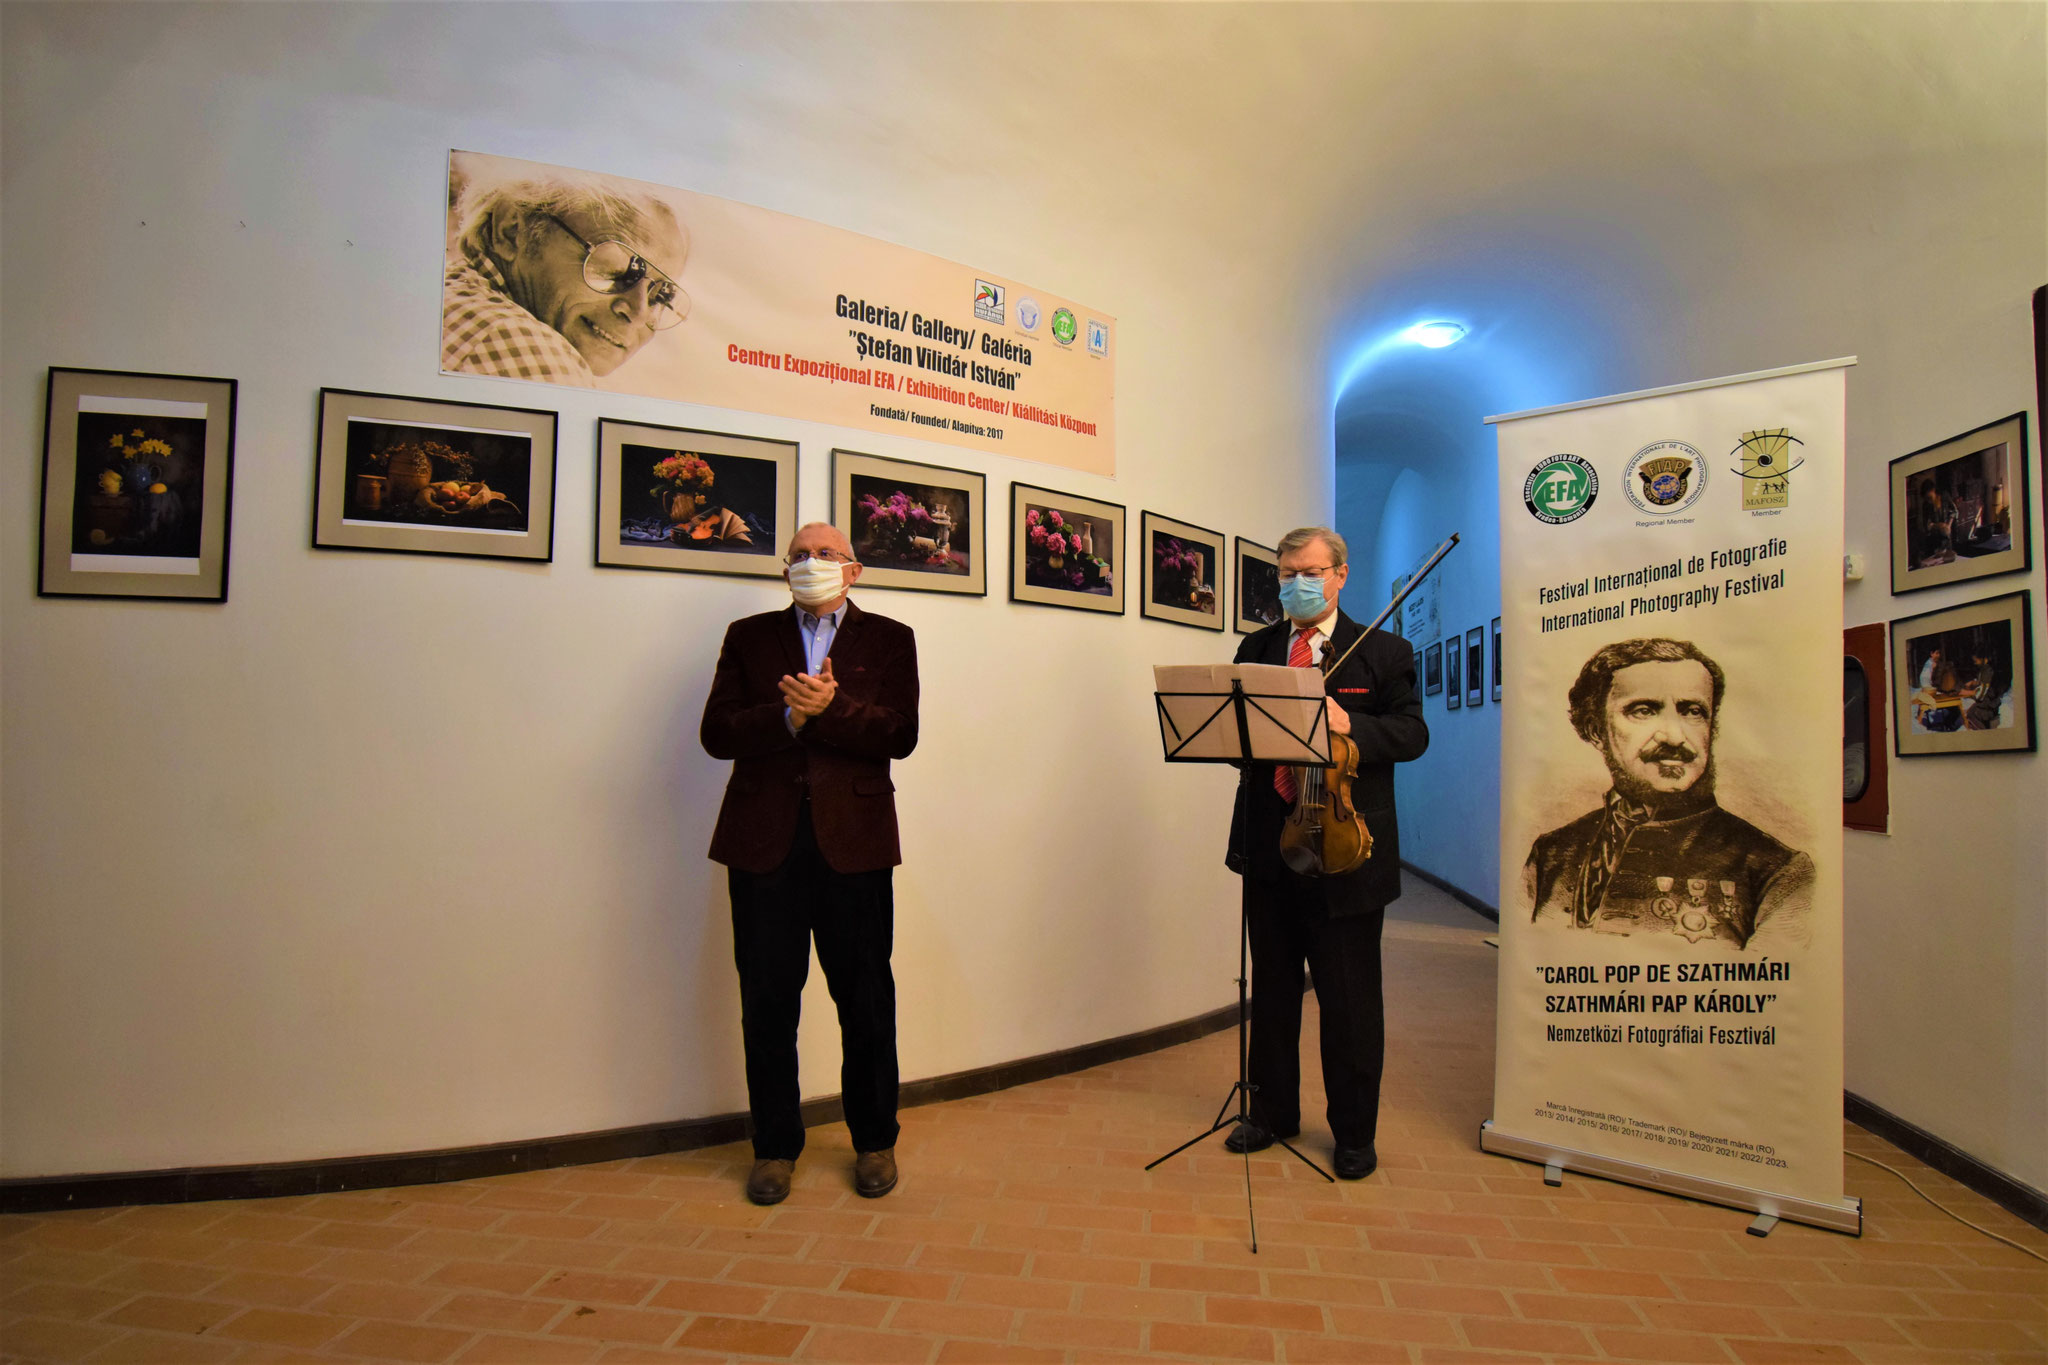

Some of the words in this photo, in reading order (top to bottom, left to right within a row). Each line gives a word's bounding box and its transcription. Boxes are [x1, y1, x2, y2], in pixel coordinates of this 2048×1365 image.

[835, 293, 908, 330] Galeria/
[911, 313, 976, 351] Gallery/
[981, 332, 1032, 366] Galéria
[916, 345, 968, 379] Vilidár
[727, 343, 780, 370] Centru
[784, 353, 871, 386] Expozițional
[874, 369, 895, 391] EFA
[897, 375, 905, 392] /
[906, 377, 966, 406] Exhibition
[968, 391, 1010, 416] Center/
[1012, 401, 1058, 428] Kiállítási
[1060, 413, 1097, 438] Központ
[870, 404, 909, 423] Fondată/
[911, 411, 950, 431] Founded/
[952, 420, 985, 438] Alapítva:
[987, 426, 1004, 440] 2017
[1627, 443, 1665, 477] INTERNATIONALE
[1647, 460, 1685, 475] FIAP
[1544, 480, 1582, 502] EFA
[1745, 496, 1784, 506] MAFOSZ
[1635, 520, 1665, 528] Regional
[1667, 517, 1695, 525] Member
[1751, 509, 1782, 517] Member
[1539, 579, 1589, 605] Festival
[1594, 559, 1682, 593] Internațional
[1688, 555, 1705, 574] de
[1711, 537, 1787, 571] Fotografie
[1541, 601, 1625, 633] International
[1630, 584, 1719, 616] Photography
[1725, 568, 1785, 599] Festival
[1605, 965, 1641, 983] POP
[1647, 964, 1671, 983] DE
[1677, 957, 1790, 982] SZATHMÁRI
[1545, 989, 1645, 1013] SZATHMÁRI
[1652, 994, 1687, 1013] PAP
[1547, 1024, 1622, 1043] Nemzetközi
[1628, 1025, 1703, 1047] Fotográfiai
[1710, 1026, 1776, 1045] Fesztivál
[1535, 1109, 1555, 1119] 2013/
[1556, 1114, 1576, 1124] 2014/
[1577, 1118, 1598, 1129] 2015/
[1599, 1123, 1620, 1133] 2016/
[1621, 1127, 1643, 1138] 2017/
[1644, 1132, 1666, 1143] 2018/
[1667, 1137, 1690, 1148] 2019/
[1691, 1142, 1714, 1153] 2020/
[1715, 1147, 1739, 1158] 2021/
[1740, 1152, 1764, 1163] 2022/
[1765, 1157, 1789, 1169] 2023.
[1628, 1118, 1666, 1132] Trademark
[1689, 1131, 1728, 1145] Bejegyzett
[1730, 1141, 1754, 1151] márka
[1756, 1145, 1775, 1156] (RO)
